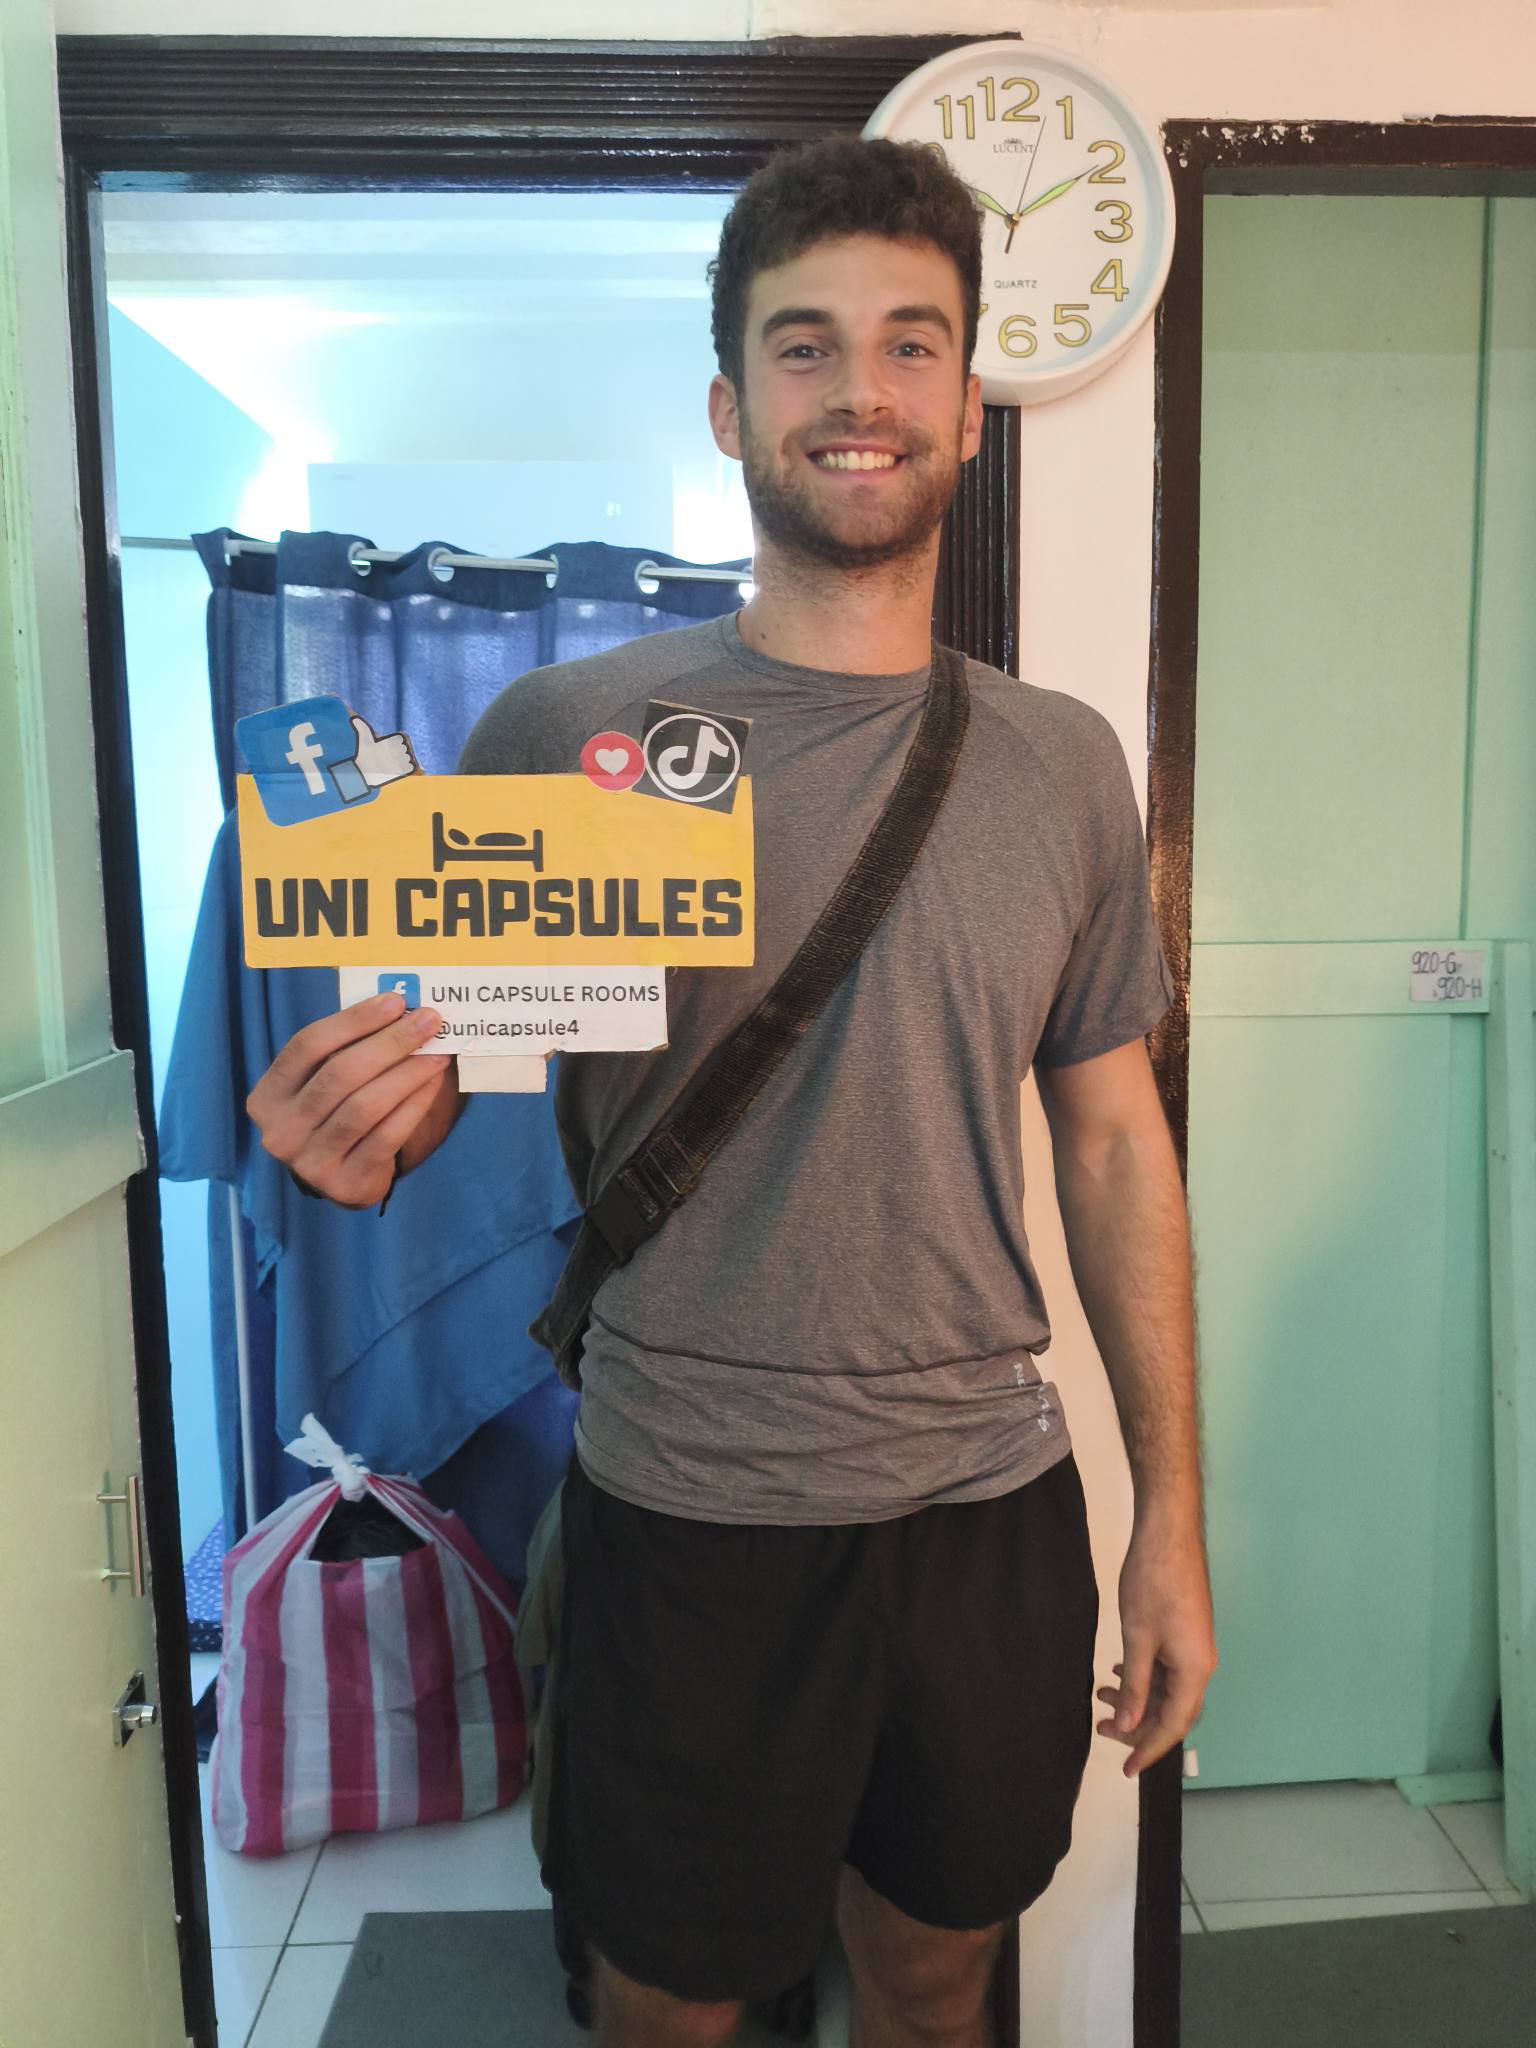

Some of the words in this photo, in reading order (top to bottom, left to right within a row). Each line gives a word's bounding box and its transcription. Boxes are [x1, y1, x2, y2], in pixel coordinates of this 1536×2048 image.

[934, 95, 976, 140] 11
[977, 77, 1040, 122] 12
[1055, 95, 1074, 140] 1
[993, 143, 1035, 154] LUCENT
[1087, 140, 1127, 184] 2
[1094, 200, 1133, 243] 3
[994, 279, 1038, 290] QUARTZ
[1090, 258, 1129, 302] 4
[999, 315, 1037, 358] 6
[1054, 304, 1092, 347] 5
[254, 877, 369, 938] UNI
[395, 877, 743, 938] CAPSULES
[431, 985, 470, 1003] UNI
[476, 985, 575, 1003] CAPSULE
[581, 985, 660, 1003] ROOMS
[433, 1018, 580, 1039] @unicapsule4
